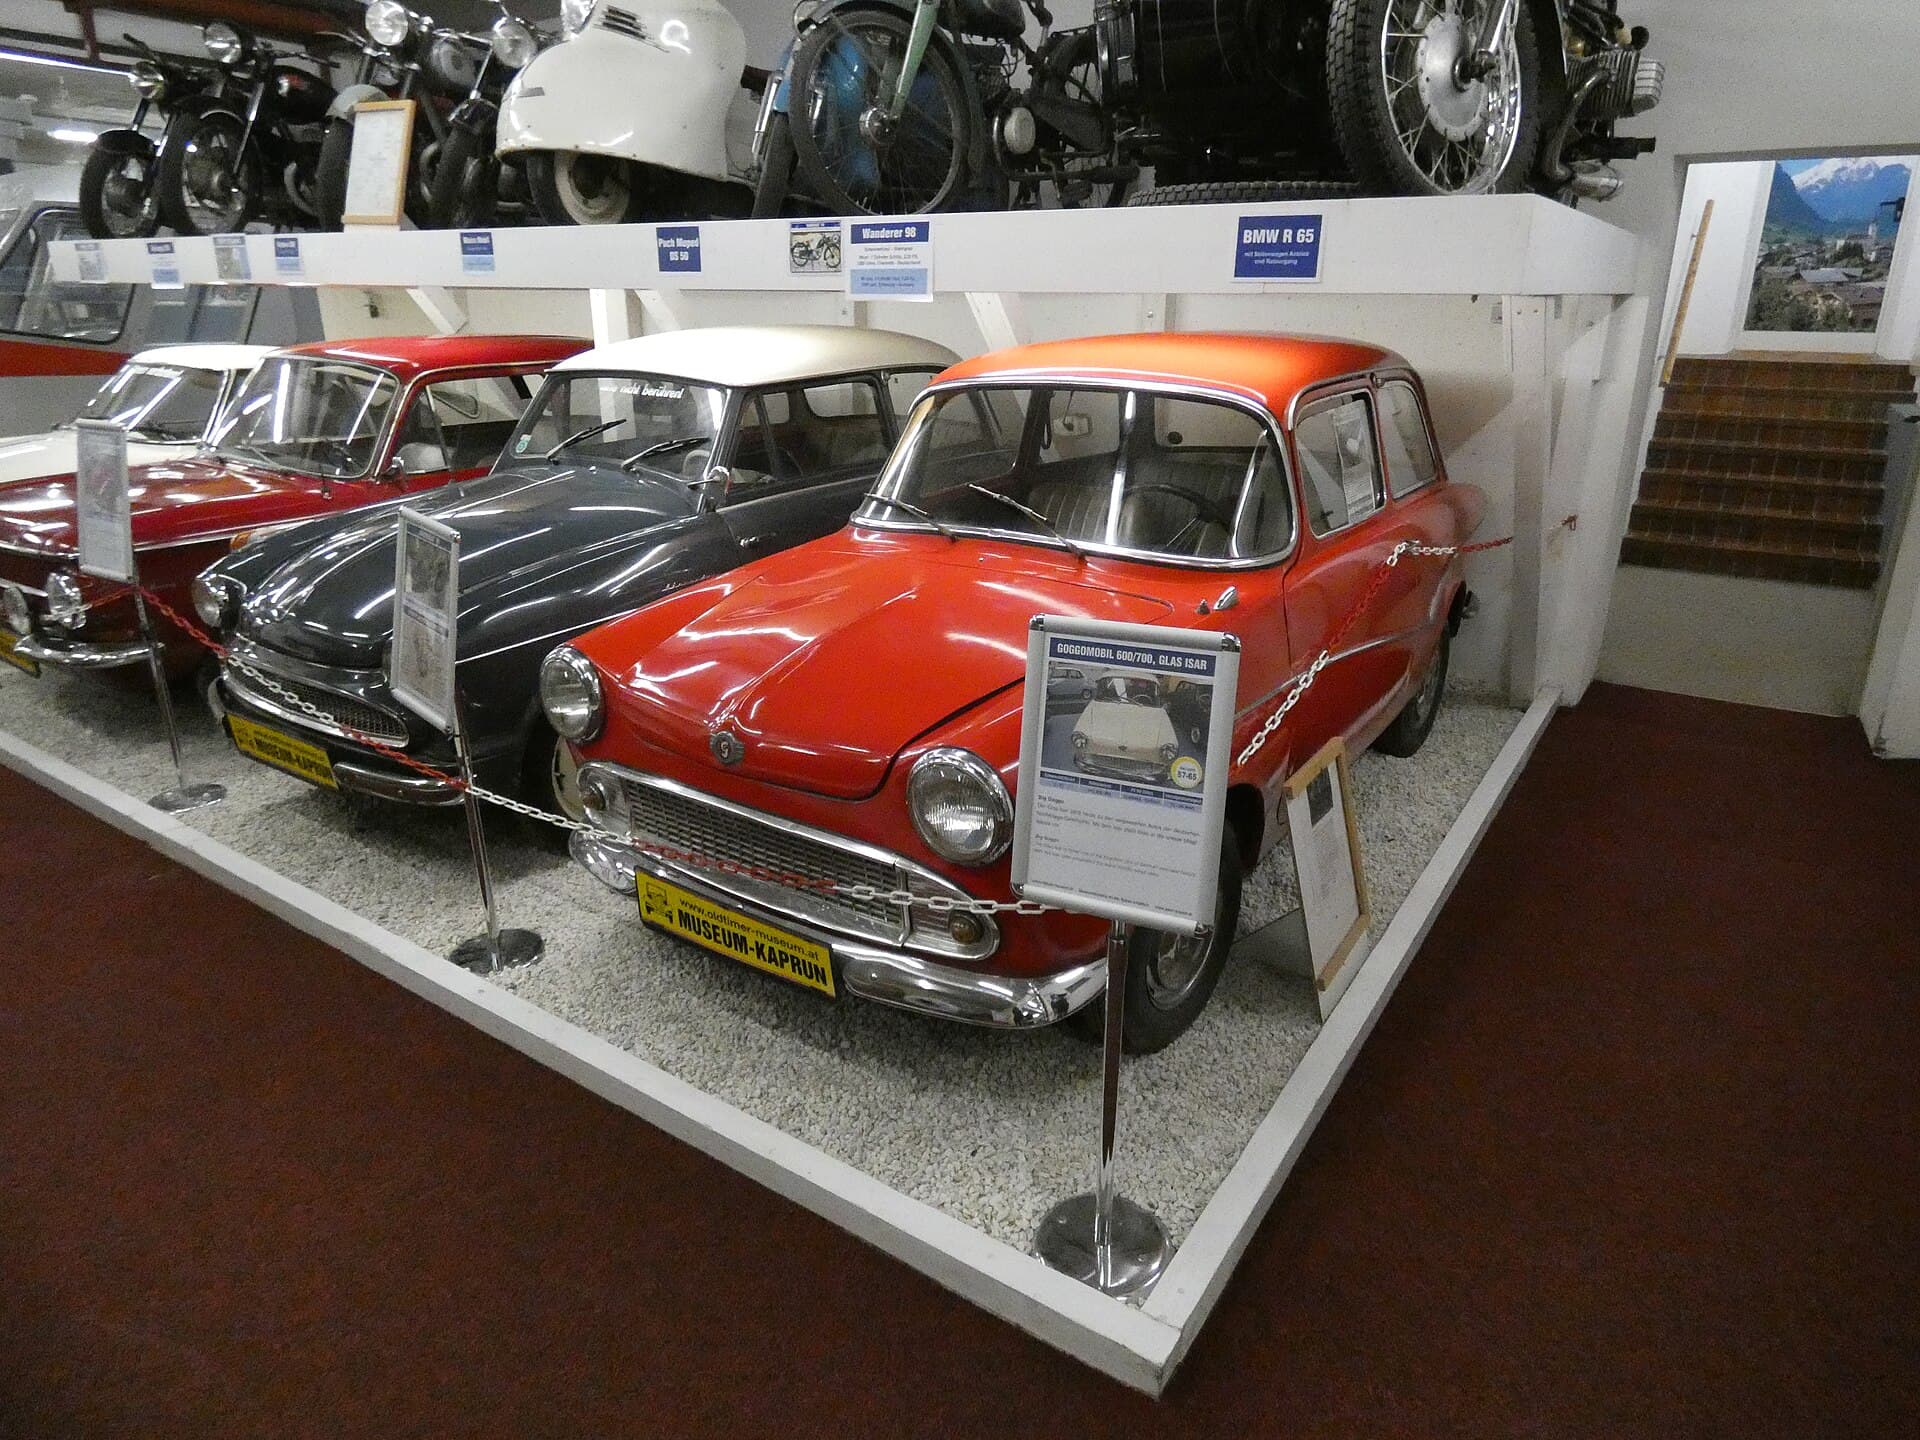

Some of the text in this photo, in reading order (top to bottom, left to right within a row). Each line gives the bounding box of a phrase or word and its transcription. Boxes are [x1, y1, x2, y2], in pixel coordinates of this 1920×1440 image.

[862, 226, 917, 239] Wanderer 98
[1243, 228, 1315, 244] BMW R 65
[1057, 643, 1115, 660] GOGGOMOBIL
[1158, 655, 1183, 668] GLAS
[1184, 658, 1208, 670] ISAR
[1177, 770, 1197, 781] 57-65
[679, 898, 820, 961] www.oldtimer-museum.at
[678, 909, 828, 986] MUSEUM-KAPRUN
